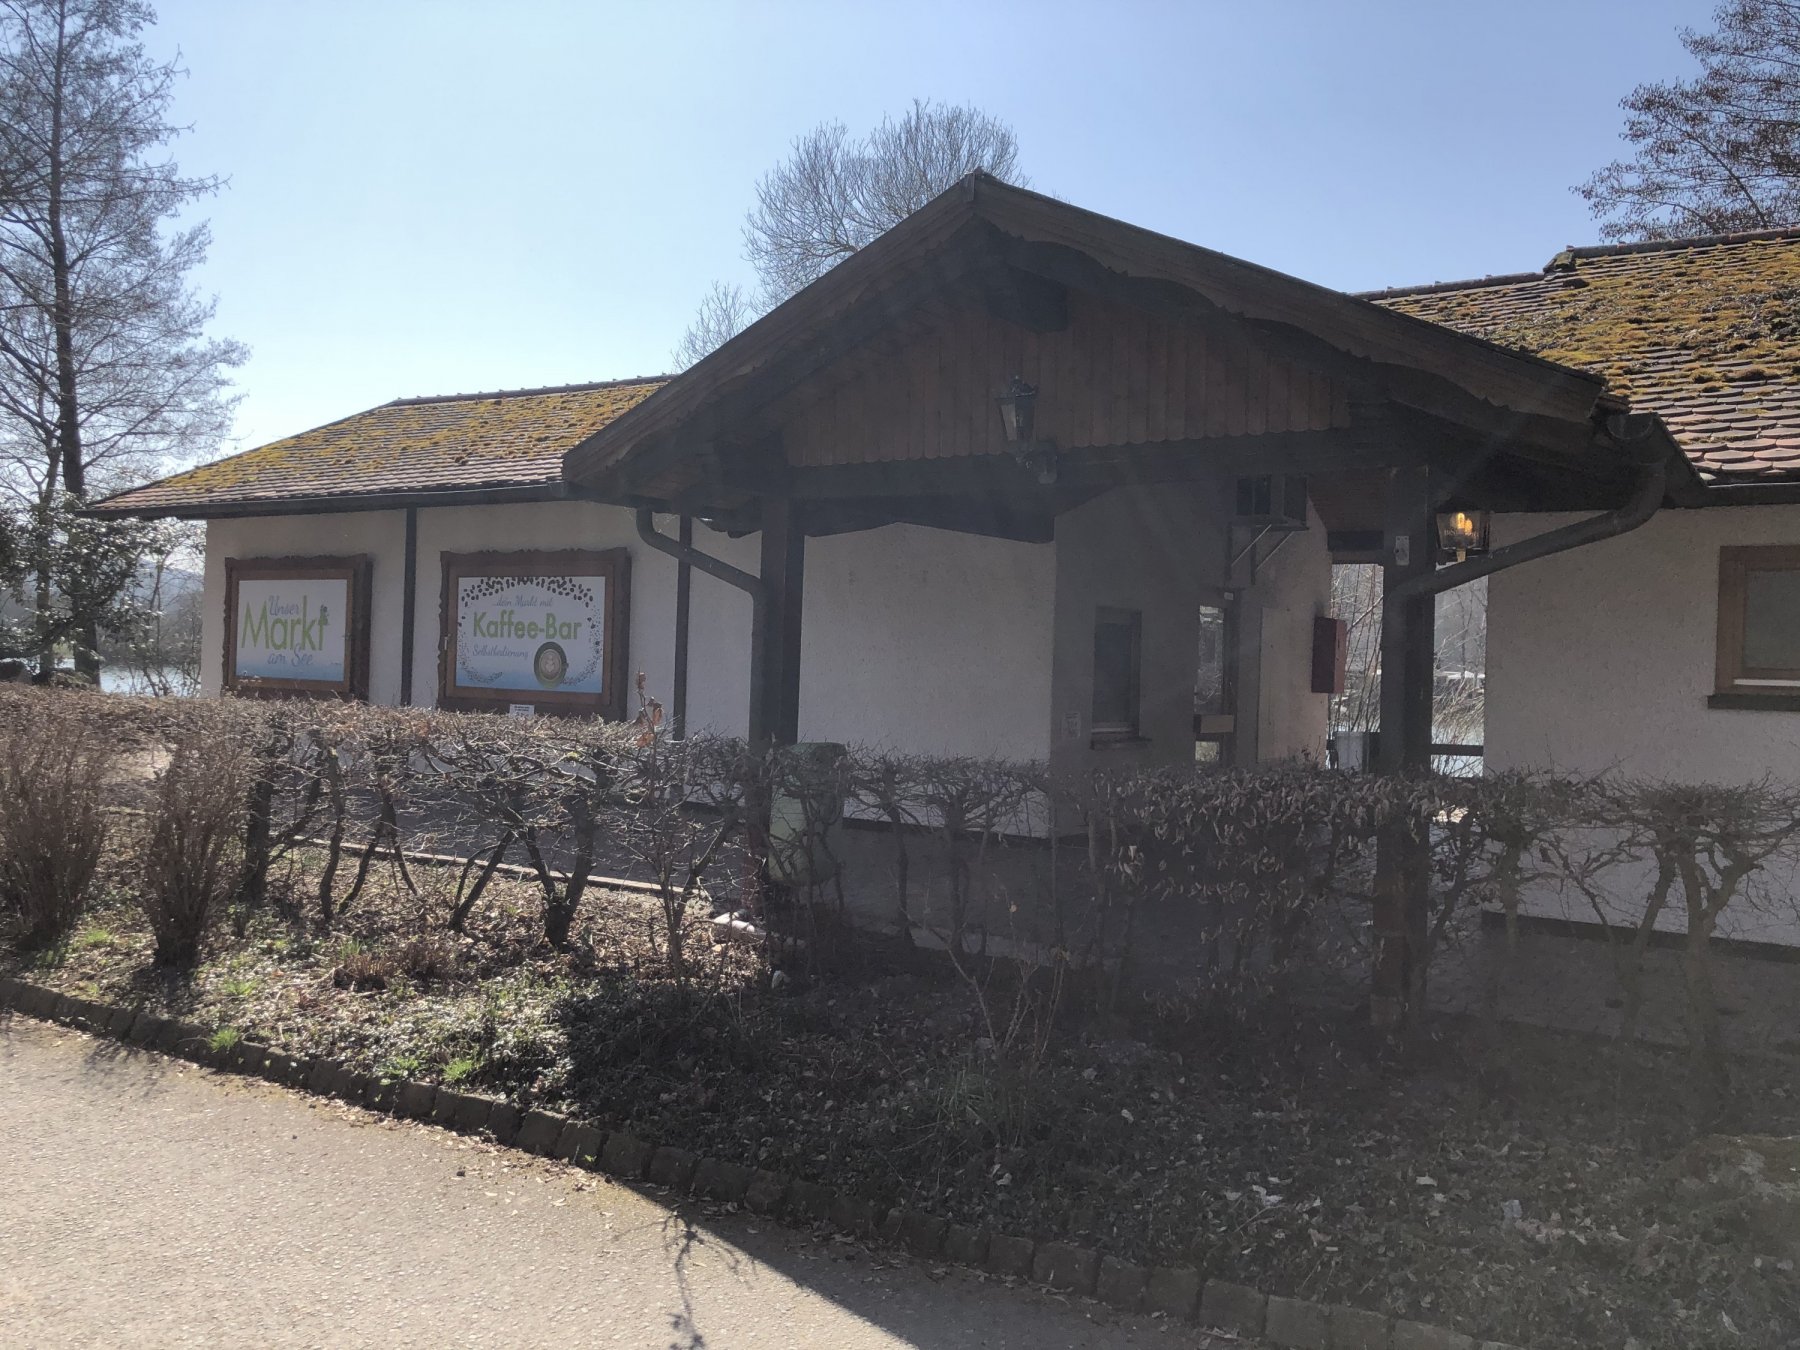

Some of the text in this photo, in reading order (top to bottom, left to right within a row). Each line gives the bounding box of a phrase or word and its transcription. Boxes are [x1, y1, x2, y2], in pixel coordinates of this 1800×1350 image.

[268, 595, 300, 616] Unser
[241, 595, 329, 651] Markt
[473, 609, 583, 640] Kaffee-Bar
[267, 643, 313, 667] am See
[472, 644, 529, 660] Selbstbedienung
